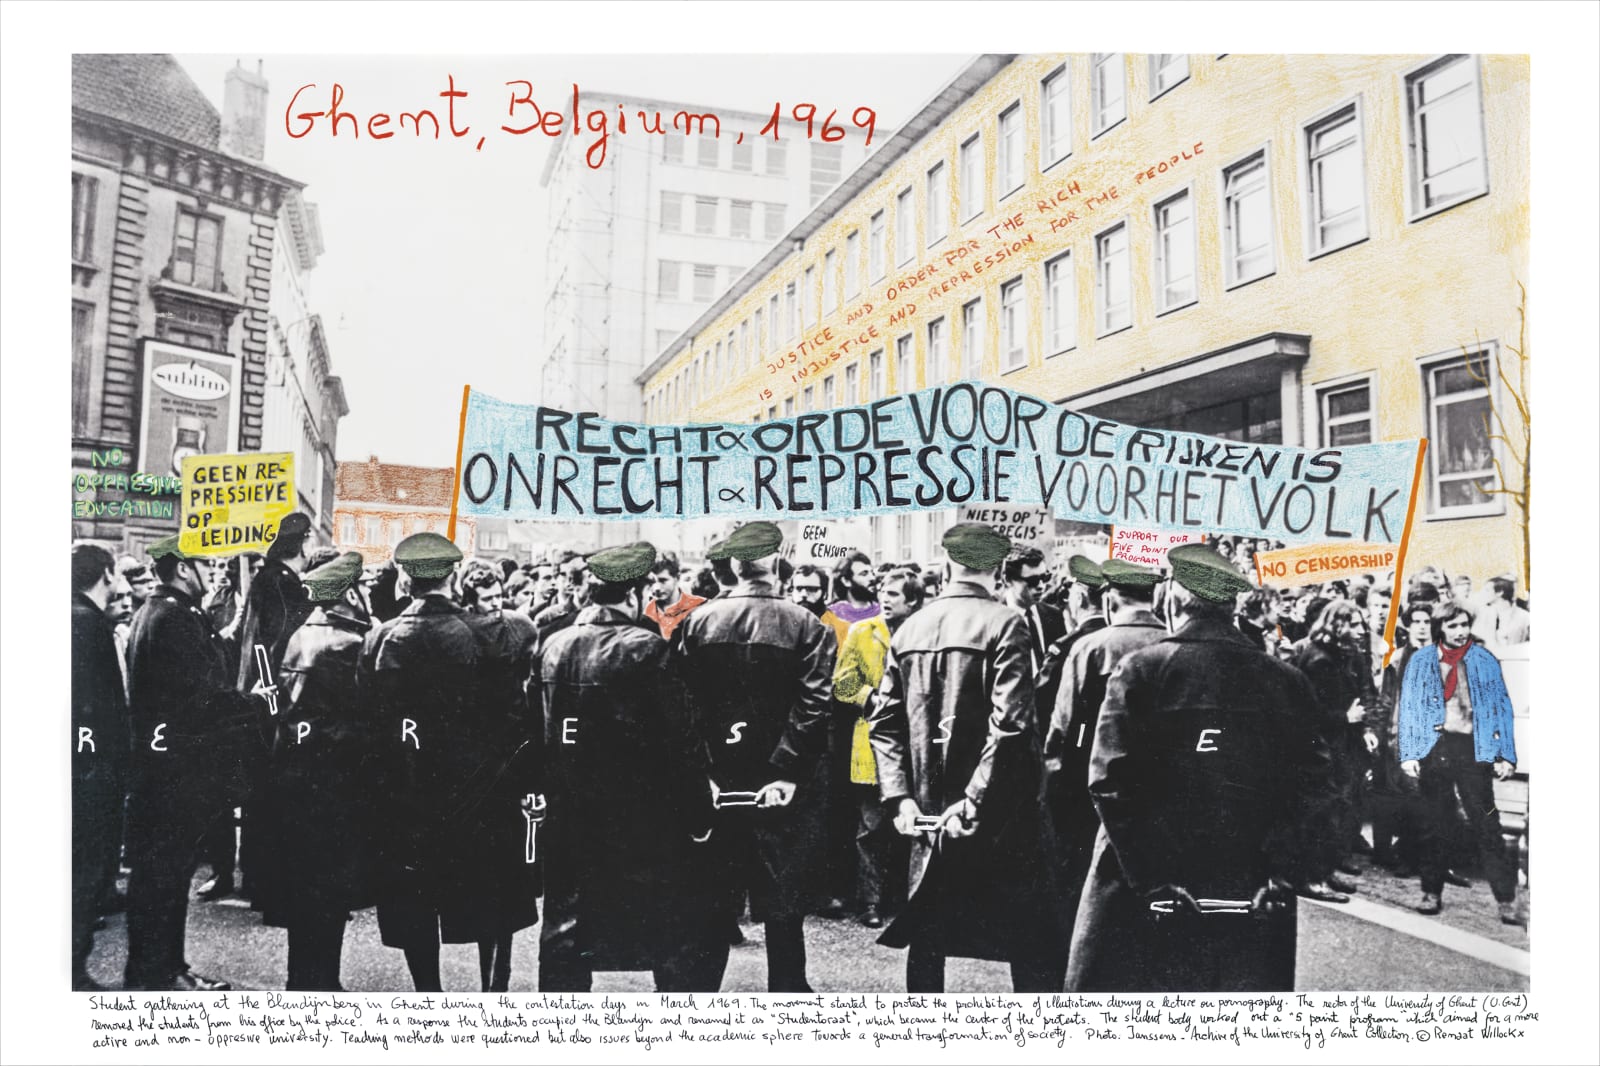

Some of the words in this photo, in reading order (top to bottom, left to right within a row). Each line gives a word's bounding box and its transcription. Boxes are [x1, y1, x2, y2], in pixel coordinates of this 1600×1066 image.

[283, 74, 485, 150] Ghent,
[501, 80, 743, 170] Belgium,
[760, 102, 876, 146] 1969
[759, 388, 773, 401] IS
[791, 325, 879, 383] INJUSTICE
[889, 303, 917, 326] AND
[928, 234, 1035, 301] REPRESSION
[1050, 211, 1079, 233] FOR
[1084, 186, 1119, 211] THE
[1135, 141, 1204, 184] PEOPLE
[766, 327, 834, 375] JUSTICE
[846, 303, 874, 326] AND
[886, 264, 939, 301] ORDER
[943, 240, 982, 266] FOR
[986, 212, 1026, 240] THE
[1037, 180, 1082, 214] RICH
[534, 405, 722, 456] RECHT
[752, 396, 904, 456] ORDE
[907, 383, 1048, 449] VOOR
[1055, 408, 1120, 460] DE
[1291, 449, 1343, 483] IS
[92, 448, 124, 468] NO
[193, 465, 248, 484] GEEN
[191, 481, 289, 507] PRESSIEVE
[463, 450, 721, 516] ONRECHT
[755, 444, 1017, 513] REPRESSIE
[1250, 475, 1401, 543] VOLK
[74, 501, 173, 518] EDUCATION
[187, 513, 212, 528] OP
[966, 509, 1008, 521] NIETS
[1012, 511, 1031, 524] OP
[201, 524, 277, 547] LEIDING
[803, 525, 827, 540] GEEN
[1117, 530, 1159, 542] SUPPORT
[1169, 535, 1189, 543] OUR
[1112, 542, 1133, 553] FIVE
[1141, 544, 1168, 555] POINT
[1116, 552, 1160, 565] PROGRAM
[1262, 561, 1287, 577] NO
[1294, 552, 1393, 575] CENSORSHIP
[89, 995, 137, 1011] Student
[144, 996, 206, 1020] gathering
[213, 994, 230, 1009] at
[238, 995, 260, 1009] the
[365, 997, 382, 1008] in
[391, 996, 435, 1010] Ghent
[441, 997, 487, 1021] during
[498, 995, 518, 1009] the
[525, 994, 595, 1010] contestation
[601, 995, 626, 1018] days
[636, 999, 650, 1010] in
[660, 994, 698, 1010] March
[749, 997, 767, 1010] The
[772, 995, 825, 1009] movement
[830, 995, 867, 1009] started
[875, 994, 886, 1010] to
[892, 995, 928, 1015] protest
[933, 997, 947, 1009] the
[955, 995, 1023, 1014] prohibition
[1032, 995, 1042, 1017] of
[1107, 995, 1141, 1015] during
[1146, 1000, 1155, 1009] a
[1161, 995, 1196, 1009] lecture
[1200, 1001, 1215, 1009] on
[1296, 993, 1314, 1008] The
[1322, 994, 1348, 1009] rector
[1350, 995, 1360, 1016] of
[1361, 995, 1377, 1008] the
[1385, 993, 1433, 1017] University
[1435, 996, 1445, 1017] of
[1448, 995, 1478, 1008] Ghent
[91, 1018, 134, 1031] removed
[137, 1015, 154, 1031] the
[158, 1014, 200, 1030] students
[206, 1013, 232, 1036] from
[239, 1013, 257, 1026] his
[260, 1015, 285, 1034] office
[288, 1014, 305, 1037] by
[304, 1015, 320, 1025] the
[376, 1012, 389, 1025] As
[392, 1016, 400, 1025] a
[407, 1016, 450, 1030] response
[457, 1013, 478, 1028] the
[483, 1013, 527, 1028] students
[532, 1014, 576, 1030] occupied
[582, 1013, 600, 1026] the
[660, 1013, 682, 1026] and
[687, 1012, 731, 1026] renamed
[735, 1012, 745, 1024] it
[751, 1016, 764, 1024] as
[865, 1015, 895, 1026] which
[899, 1013, 937, 1024] became
[943, 1011, 959, 1024] the
[965, 1011, 999, 1024] center
[1001, 1011, 1012, 1034] of
[1016, 1011, 1034, 1025] the
[1099, 1011, 1118, 1024] The
[1124, 1008, 1162, 1024] student
[1168, 1011, 1192, 1032] body
[1199, 1011, 1239, 1024] worked
[1251, 1011, 1269, 1022] out
[1309, 1011, 1340, 1027] point
[1406, 1011, 1438, 1024] which
[1442, 1010, 1478, 1024] aimed
[1514, 1013, 1539, 1022] more
[92, 1034, 128, 1048] active
[134, 1033, 160, 1047] and
[340, 1030, 389, 1050] Teaching
[393, 1029, 445, 1044] methods
[451, 1034, 475, 1044] were
[481, 1030, 540, 1048] questioned
[548, 1028, 567, 1044] but
[569, 1028, 592, 1044] also
[599, 1035, 630, 1044] issues
[634, 1030, 672, 1051] beyond
[678, 1029, 695, 1041] the
[698, 1028, 756, 1041] academic
[761, 1028, 804, 1045] sphere
[872, 1027, 913, 1048] general
[916, 1026, 1007, 1049] transformation
[1014, 1027, 1026, 1047] of
[1127, 1025, 1177, 1041] Janssens
[1190, 1026, 1227, 1041] Archive
[1230, 1026, 1240, 1046] of
[1243, 1026, 1259, 1038] the
[1262, 1025, 1310, 1049] University
[1315, 1028, 1326, 1048] of
[1330, 1026, 1358, 1038] Ghent
